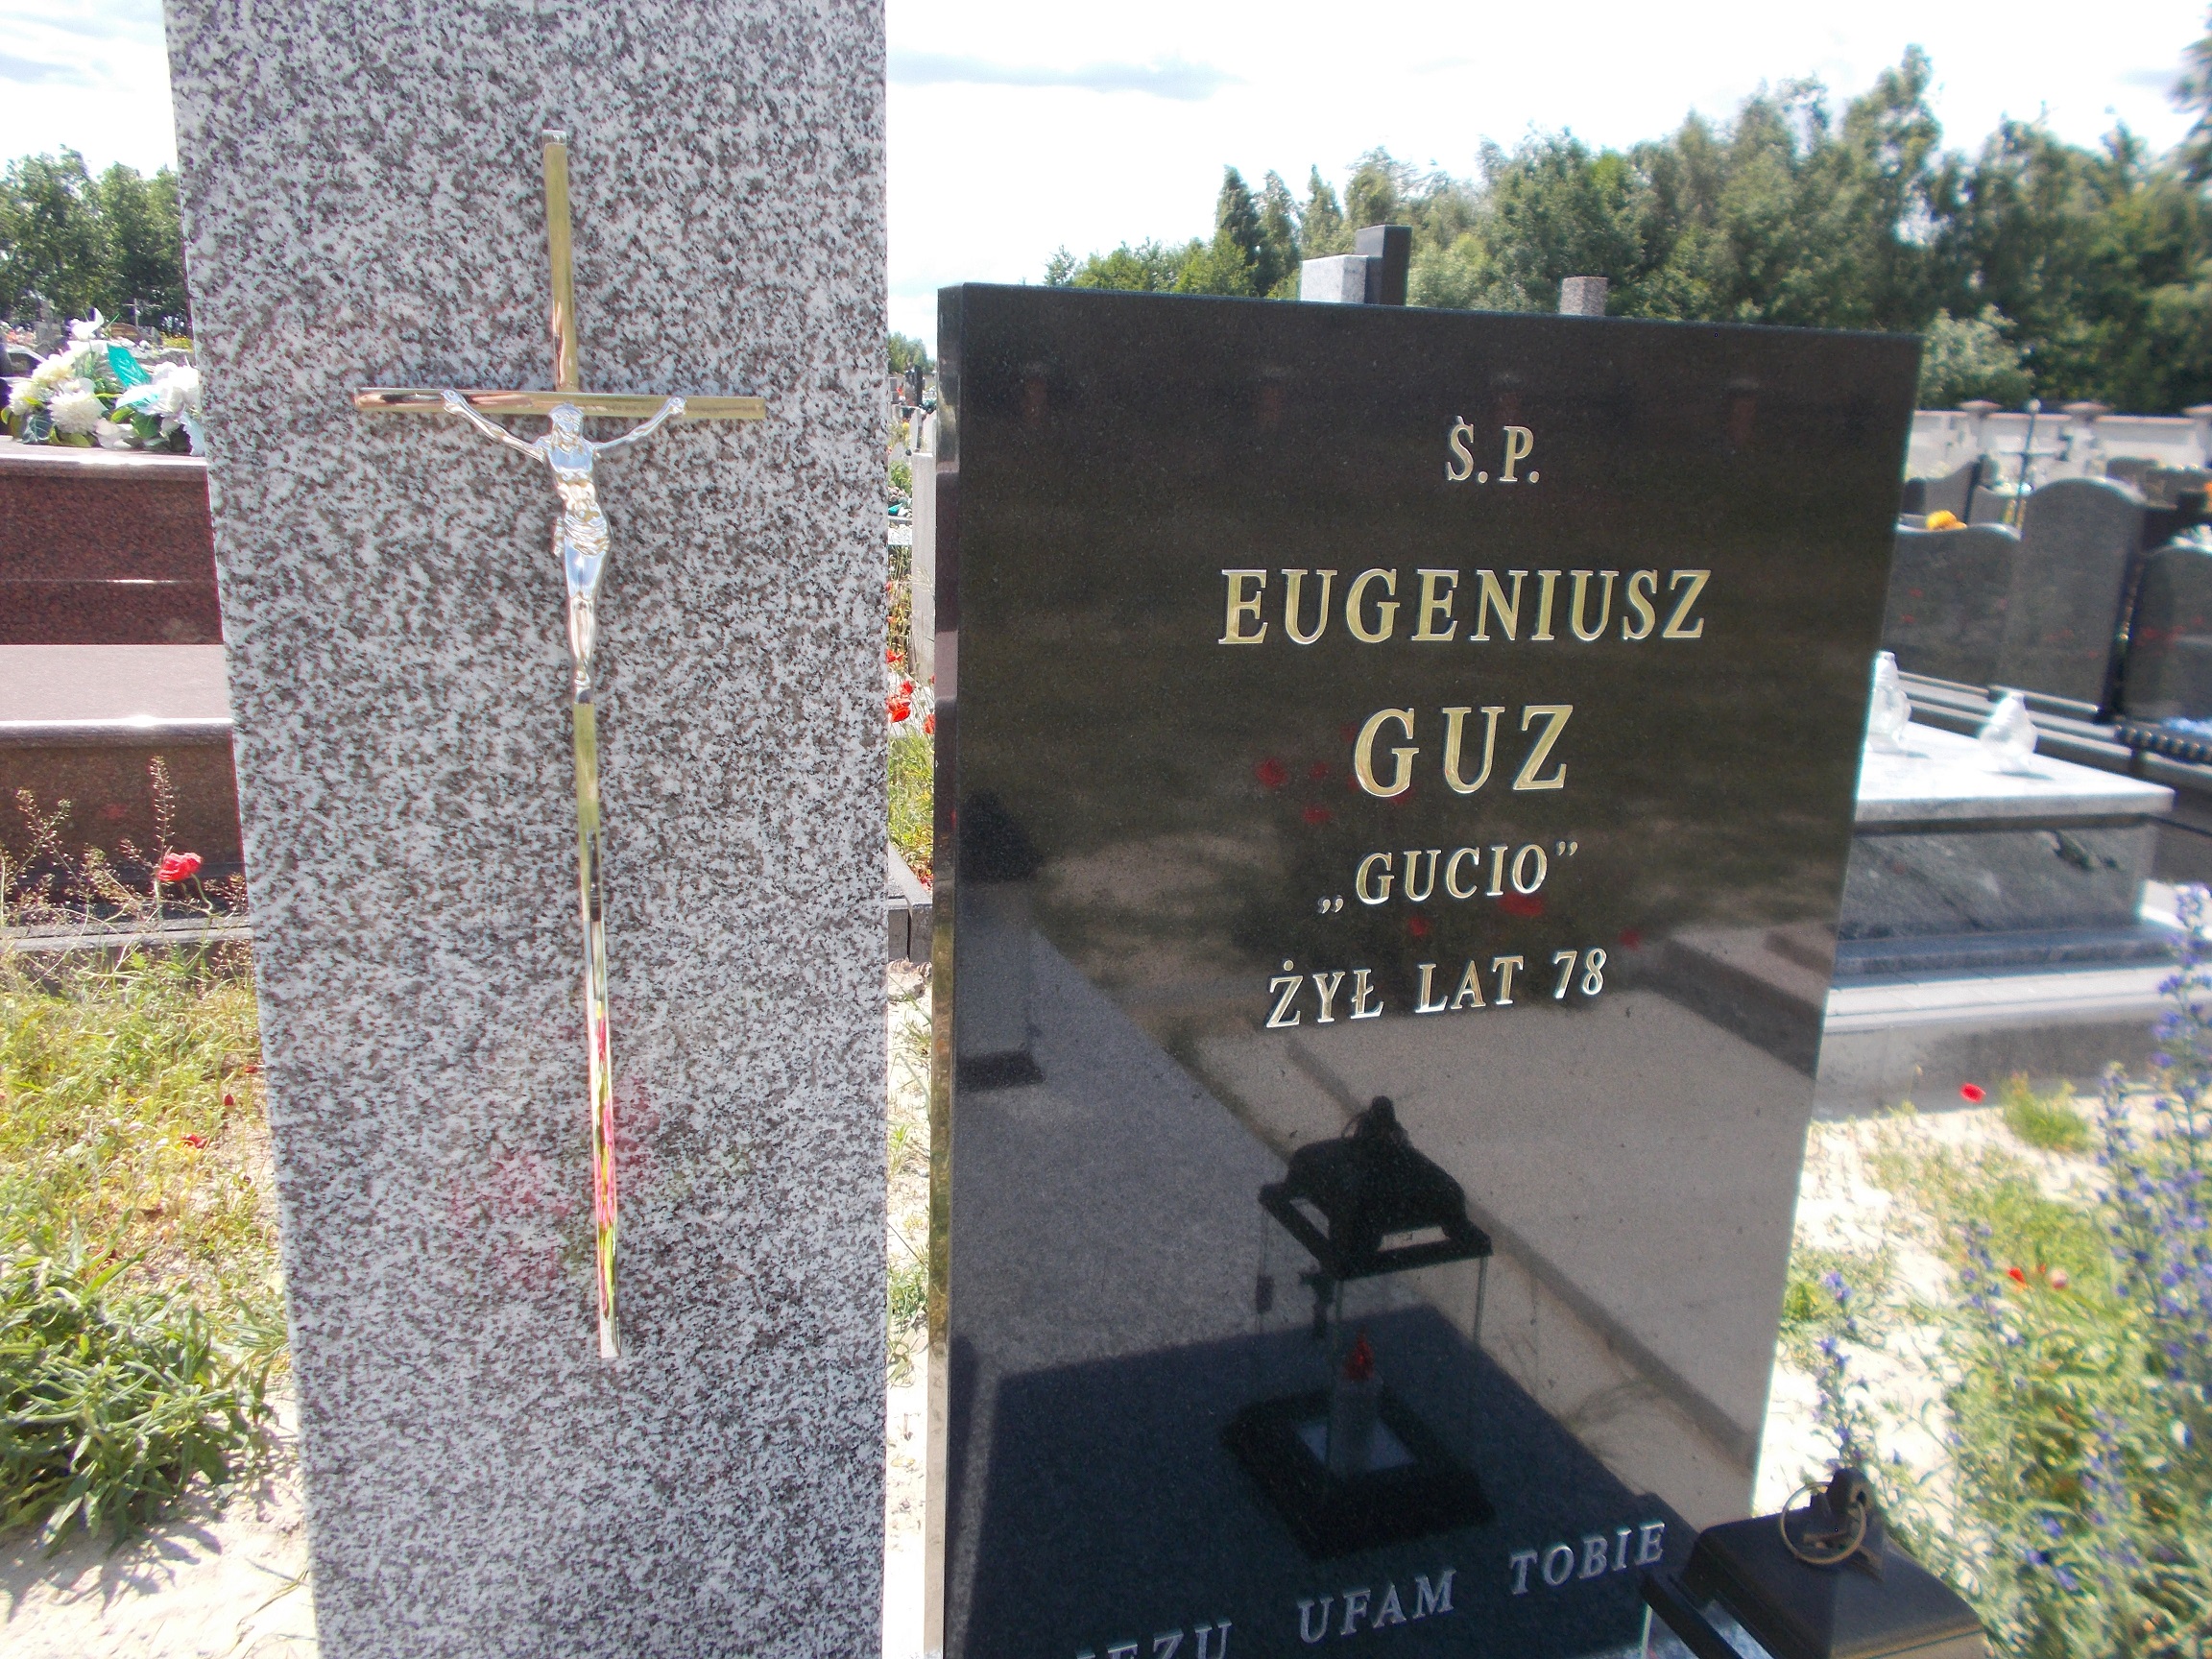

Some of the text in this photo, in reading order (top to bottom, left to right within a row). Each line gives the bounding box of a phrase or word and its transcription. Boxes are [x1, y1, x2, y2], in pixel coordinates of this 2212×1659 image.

[1217, 568, 1712, 645] EUGENIUSZ
[1354, 704, 1575, 798] GUZ
[1265, 947, 1608, 1029] ŻYŁ LAT 78
[1296, 1568, 1456, 1645] UFAM
[1508, 1522, 1667, 1595] TOBIE
